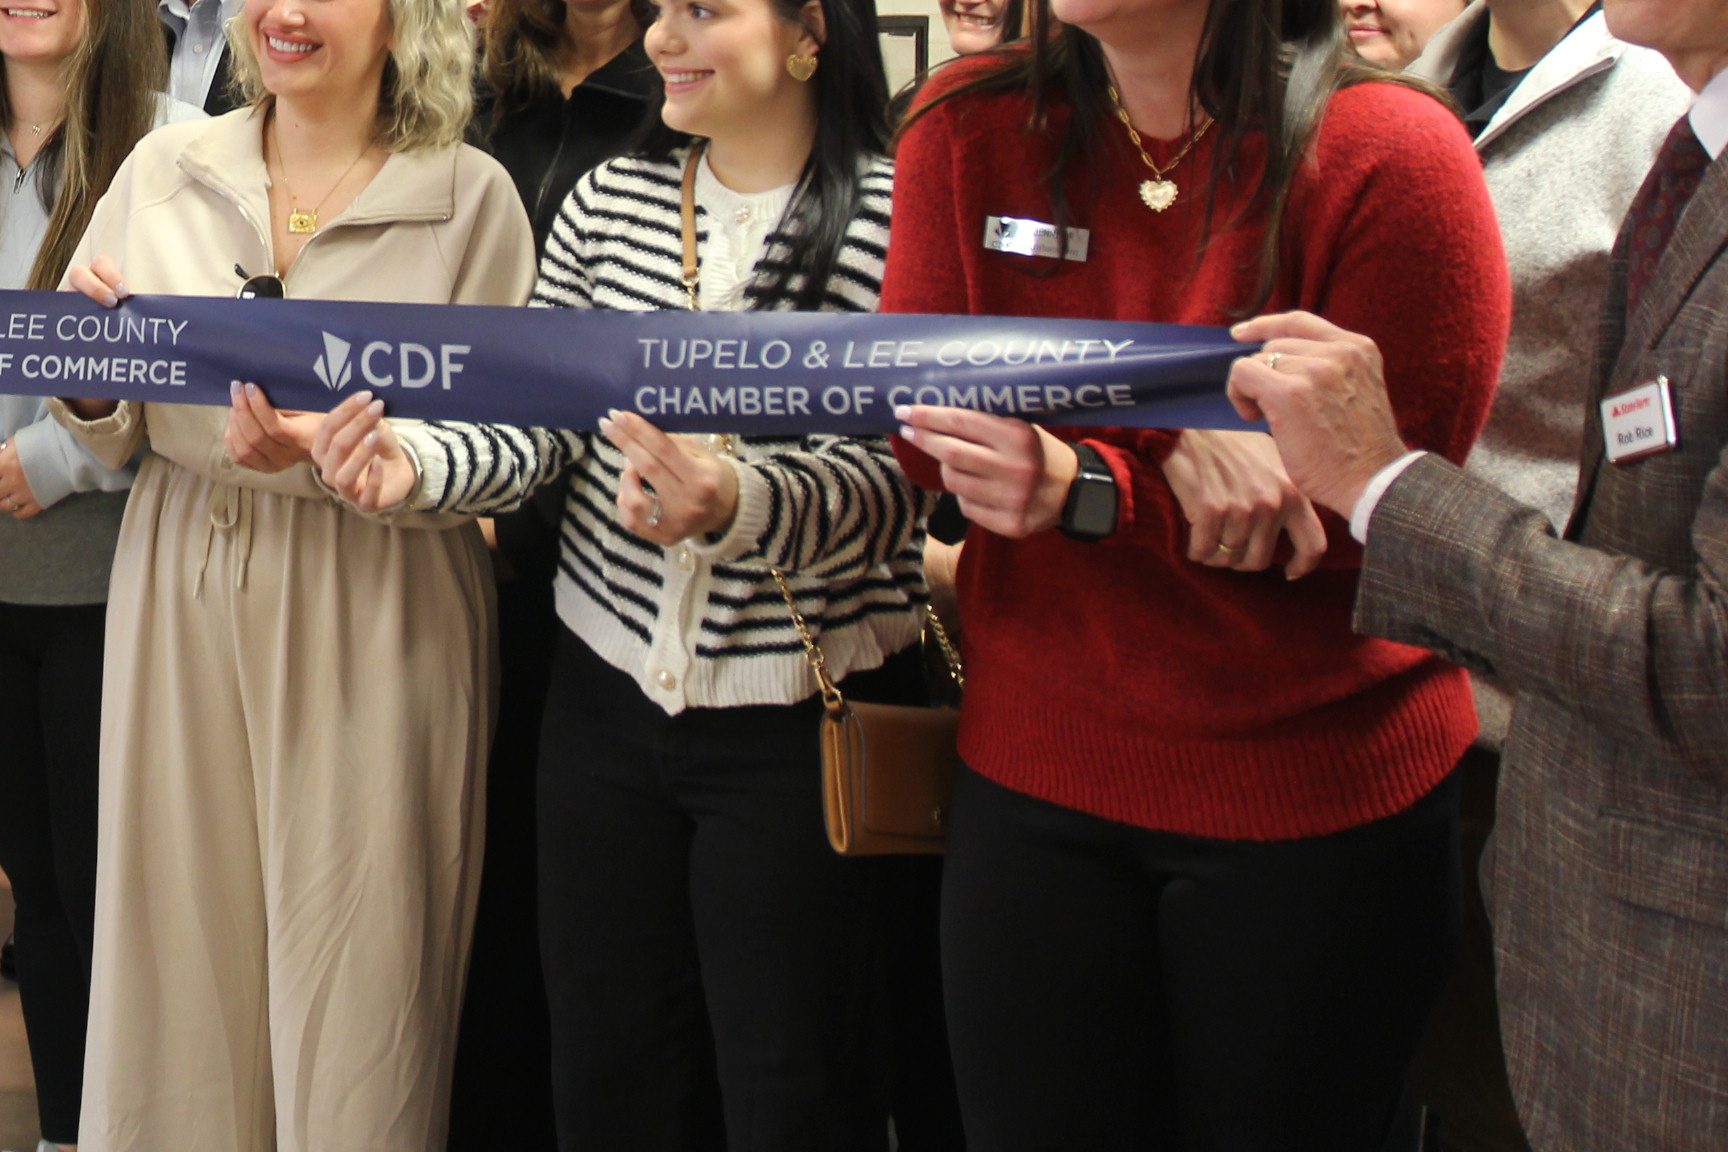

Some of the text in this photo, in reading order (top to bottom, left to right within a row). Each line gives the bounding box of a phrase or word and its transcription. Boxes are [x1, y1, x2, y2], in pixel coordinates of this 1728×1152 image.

[57, 315, 189, 347] COUNTY
[360, 341, 471, 391] CDF
[638, 338, 1135, 369] TUPELO & LEE COUNTY
[21, 355, 187, 387] COMMERCE
[634, 384, 1136, 415] CHAMBER OF COMMERCE
[1617, 427, 1654, 446] Rob Rice
